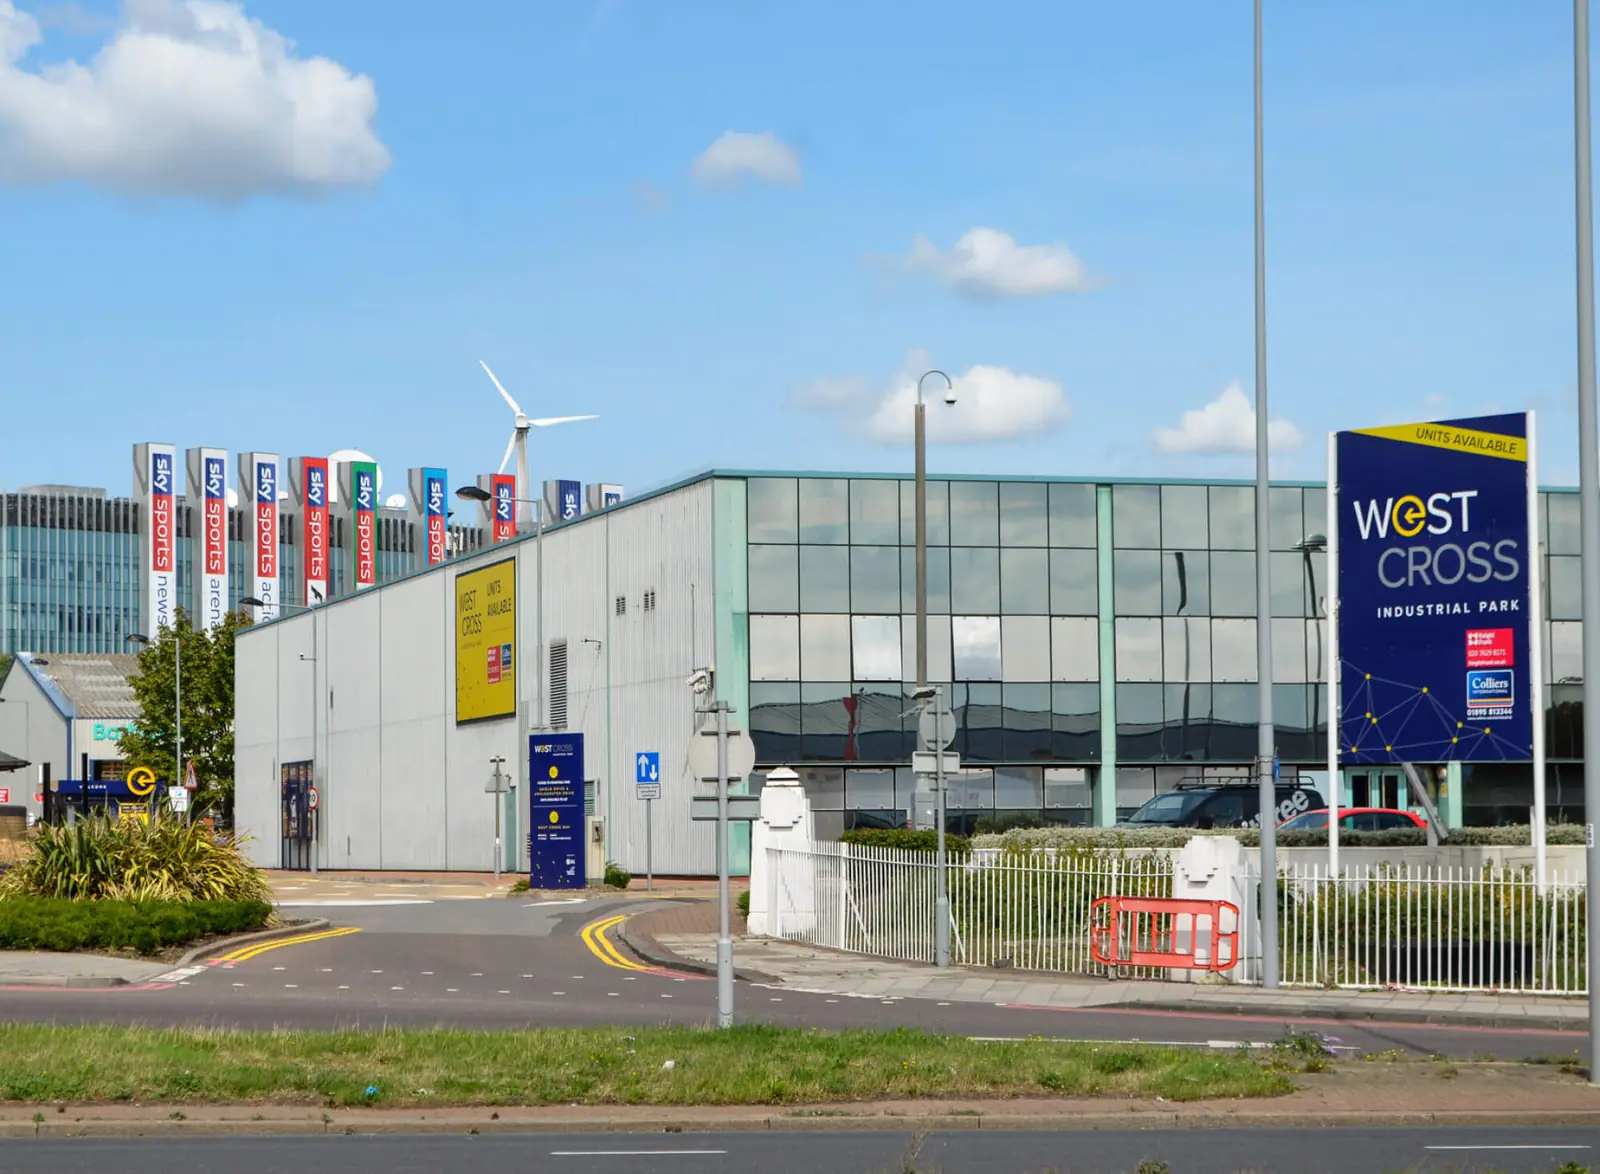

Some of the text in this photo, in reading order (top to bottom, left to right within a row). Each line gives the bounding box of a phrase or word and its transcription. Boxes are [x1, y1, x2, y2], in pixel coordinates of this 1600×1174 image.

[1416, 427, 1517, 455] UNITS AVAILABLE
[206, 463, 223, 496] sky
[258, 467, 275, 500] sky
[428, 482, 443, 513] sky
[496, 488, 511, 519] sky
[206, 503, 221, 570] sports
[308, 471, 324, 576] sky sports
[357, 476, 373, 580] sky sports
[153, 458, 171, 625] sky sports news
[258, 507, 272, 573] sports
[1377, 539, 1520, 588] CROSS
[487, 580, 501, 597] UNITS
[487, 597, 512, 617] AVAILABLE
[1377, 599, 1520, 619] INDUSTRIAL PARK
[462, 612, 482, 637] CROSS
[1472, 676, 1509, 689] Colliers
